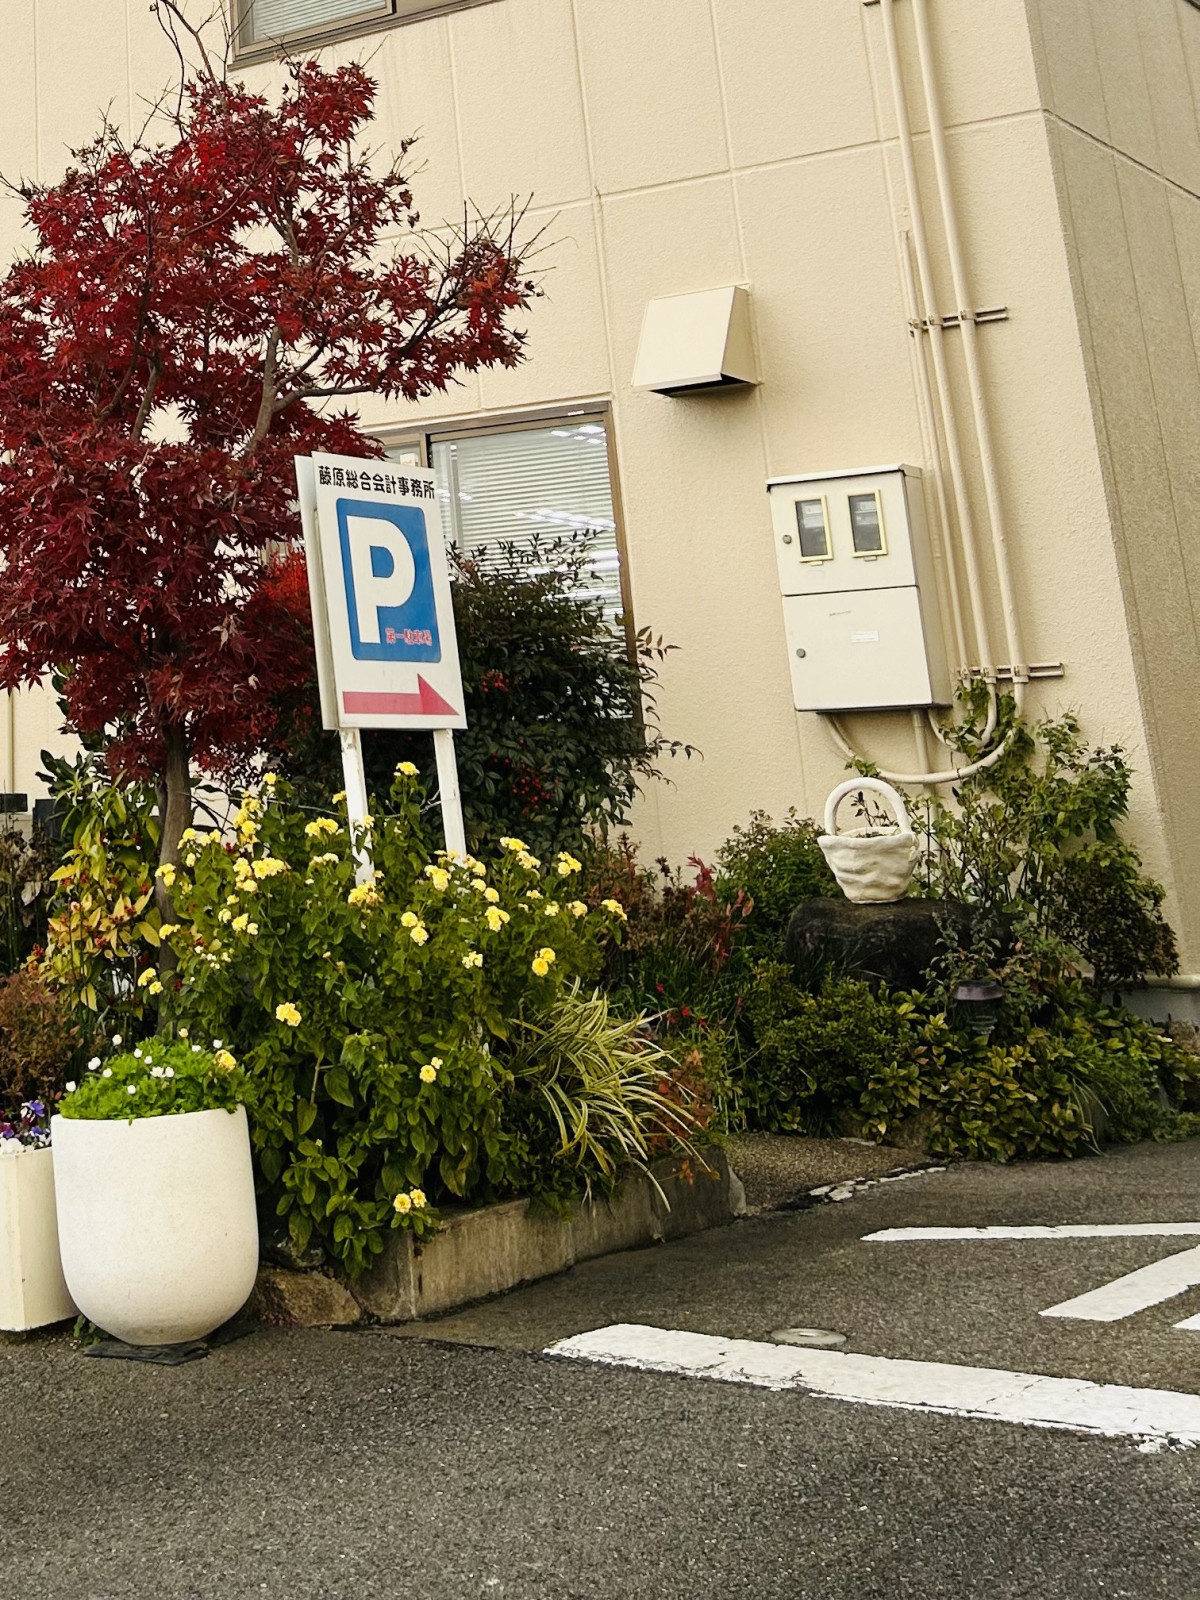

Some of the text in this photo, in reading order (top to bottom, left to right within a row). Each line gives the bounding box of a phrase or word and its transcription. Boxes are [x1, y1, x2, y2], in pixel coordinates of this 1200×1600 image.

[318, 465, 435, 500] 藤原総合会計事務所
[346, 515, 416, 644] P
